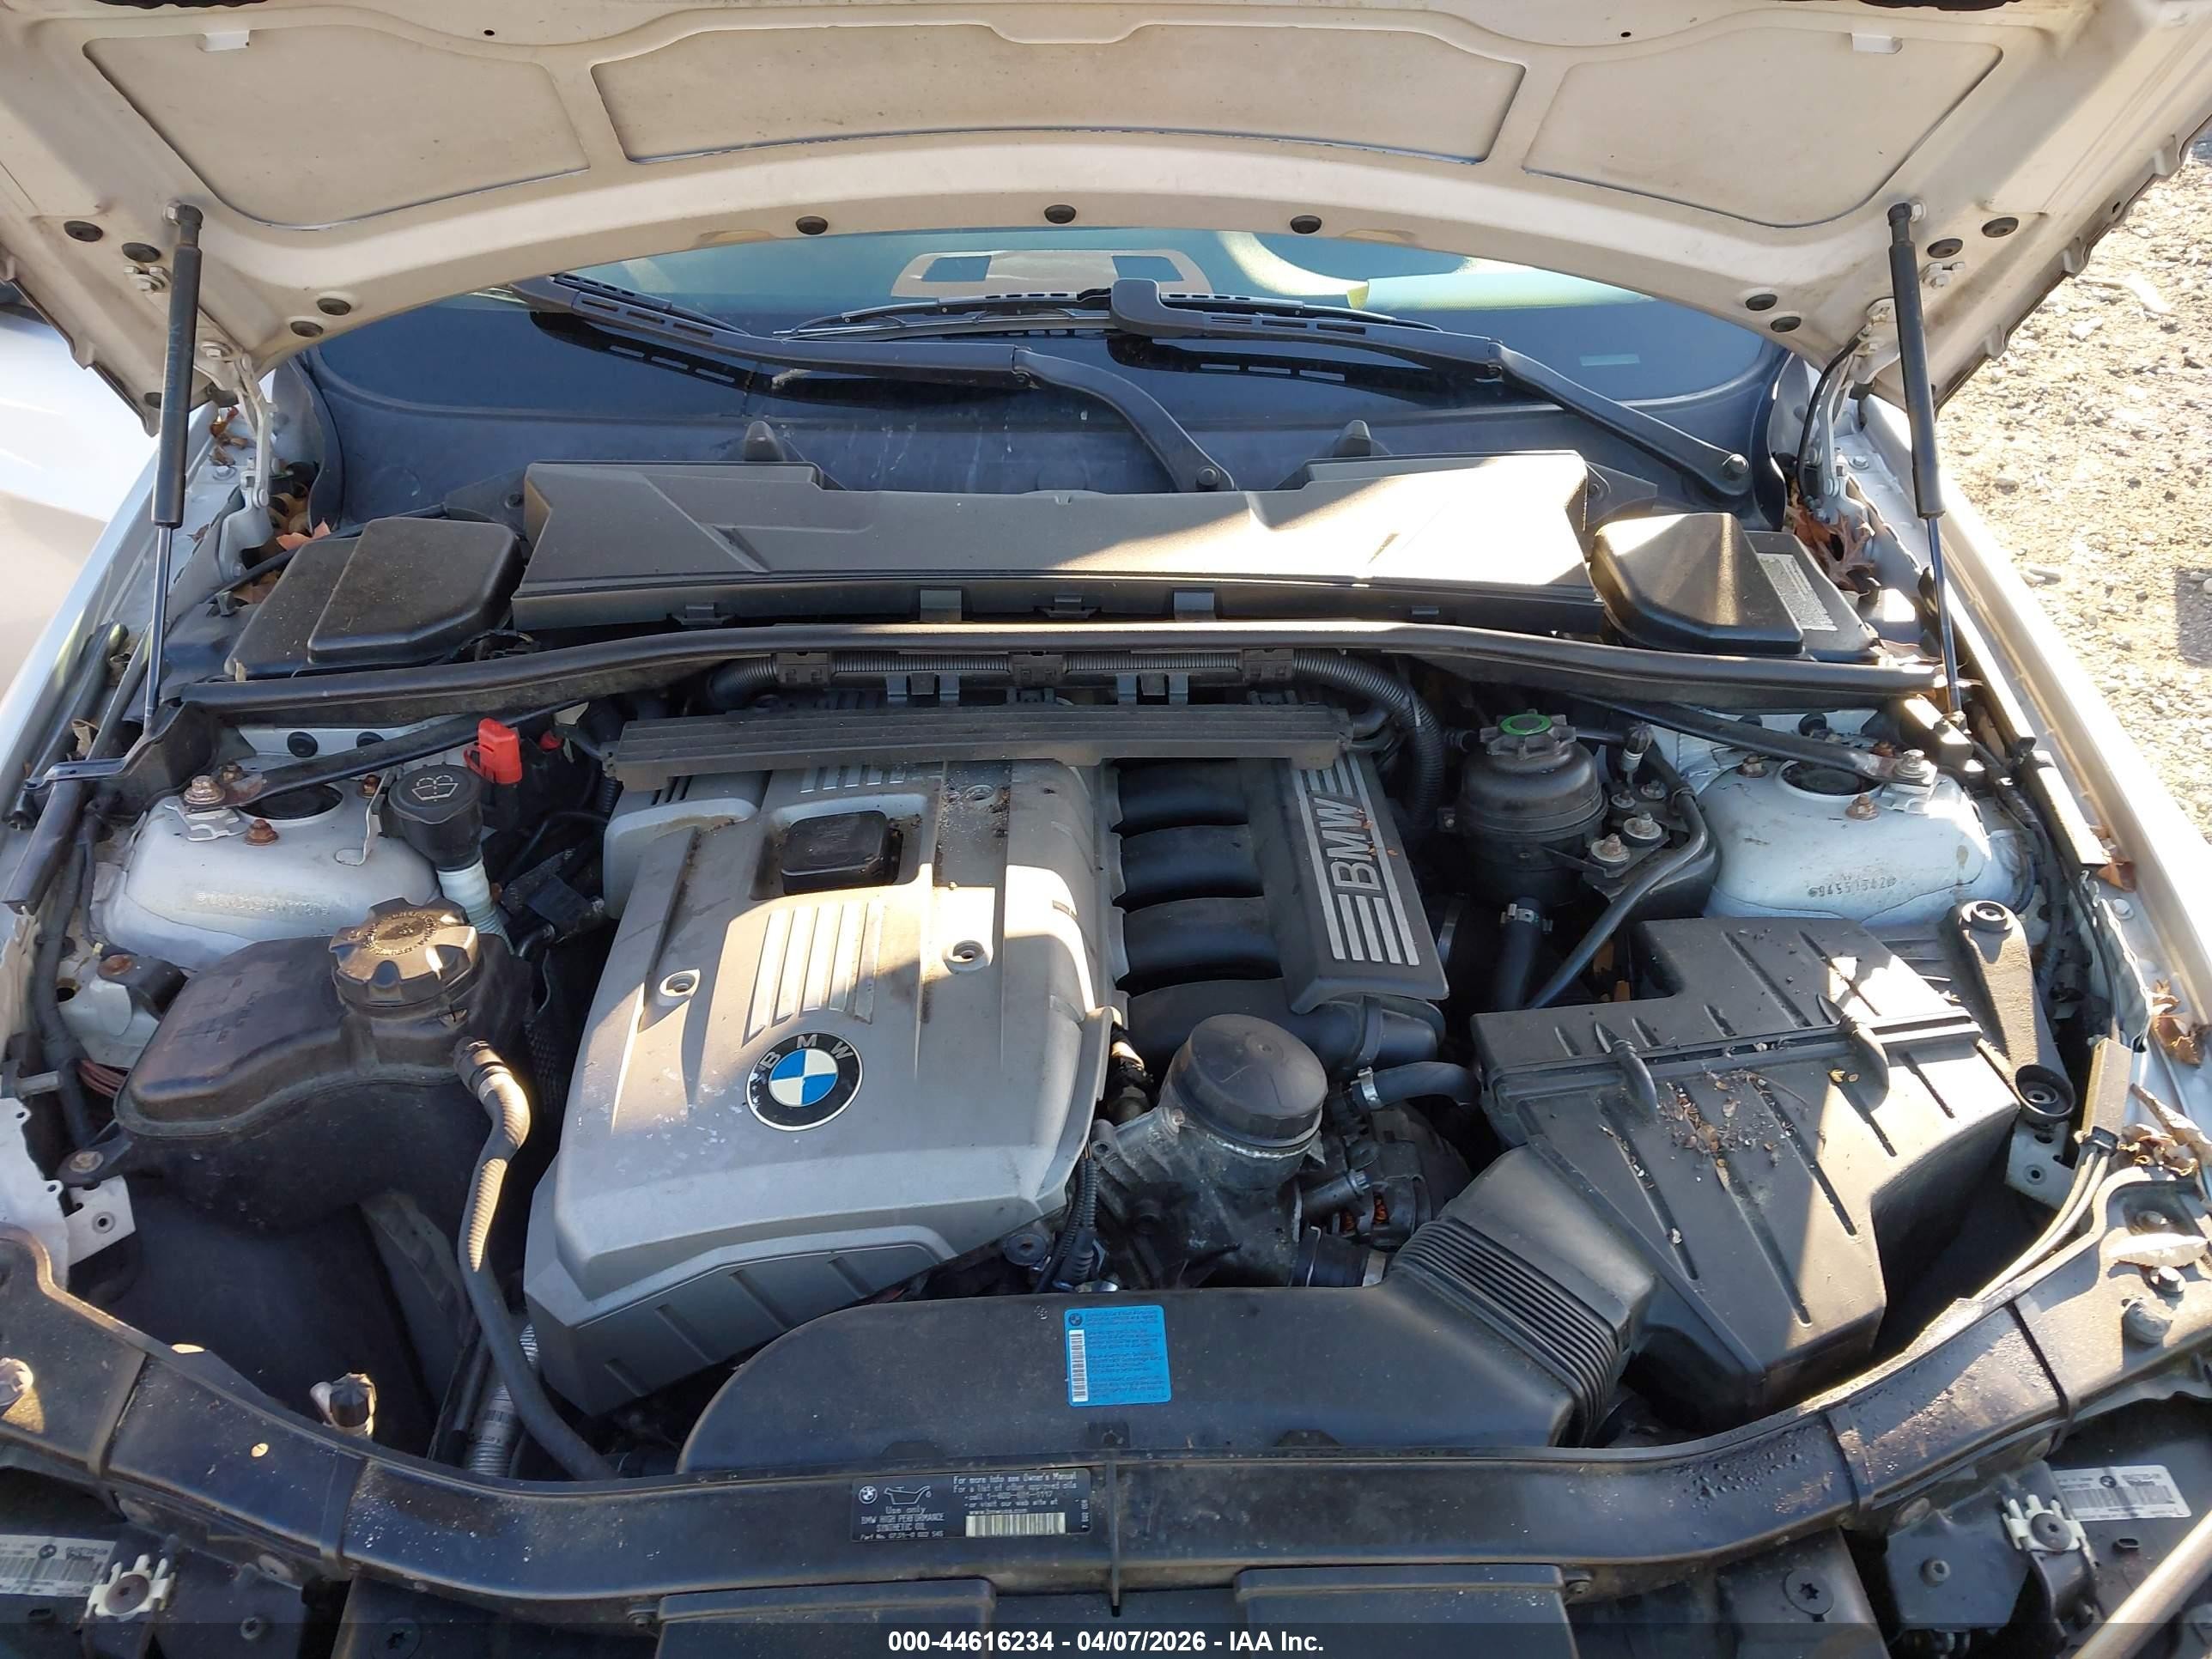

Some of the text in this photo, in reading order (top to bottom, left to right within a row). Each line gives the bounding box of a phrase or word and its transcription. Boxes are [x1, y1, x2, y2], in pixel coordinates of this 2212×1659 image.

[1314, 797, 1382, 890] BMW
[759, 1033, 854, 1069] BMW
[953, 1475, 967, 1484] For
[953, 1484, 967, 1492] For
[885, 1504, 927, 1516] Use only
[860, 1516, 877, 1524] BMW
[898, 1512, 945, 1522] PERFORMANCE
